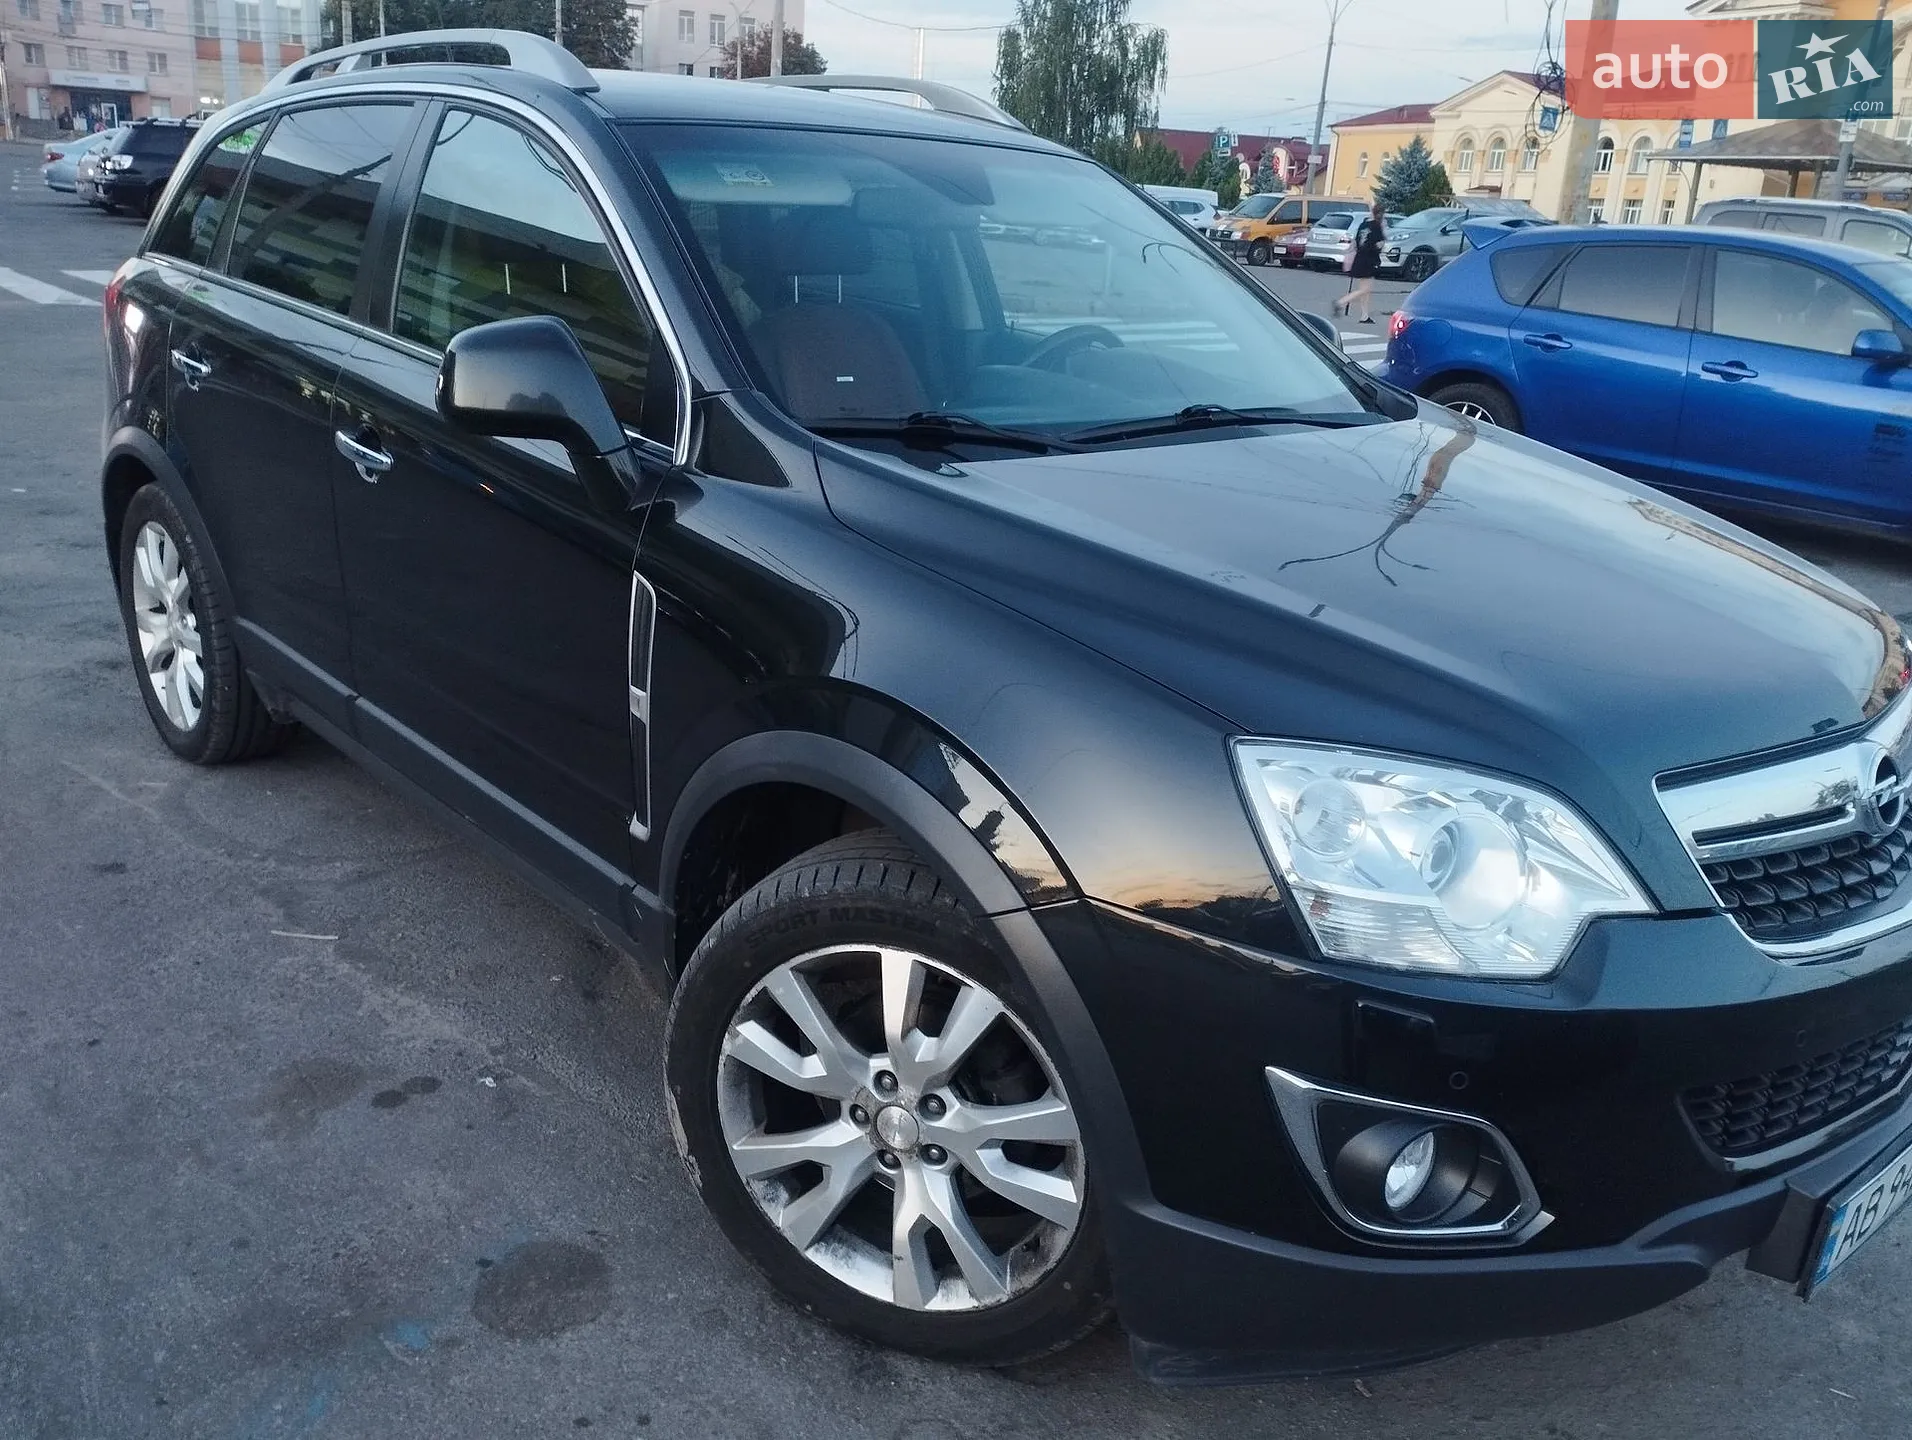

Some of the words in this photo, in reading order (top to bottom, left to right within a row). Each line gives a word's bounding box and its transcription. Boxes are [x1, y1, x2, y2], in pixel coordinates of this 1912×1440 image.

[1219, 135, 1228, 148] P
[745, 908, 820, 949] SPORT
[1835, 1184, 1885, 1260] AB
[1881, 1163, 1912, 1220] 94
